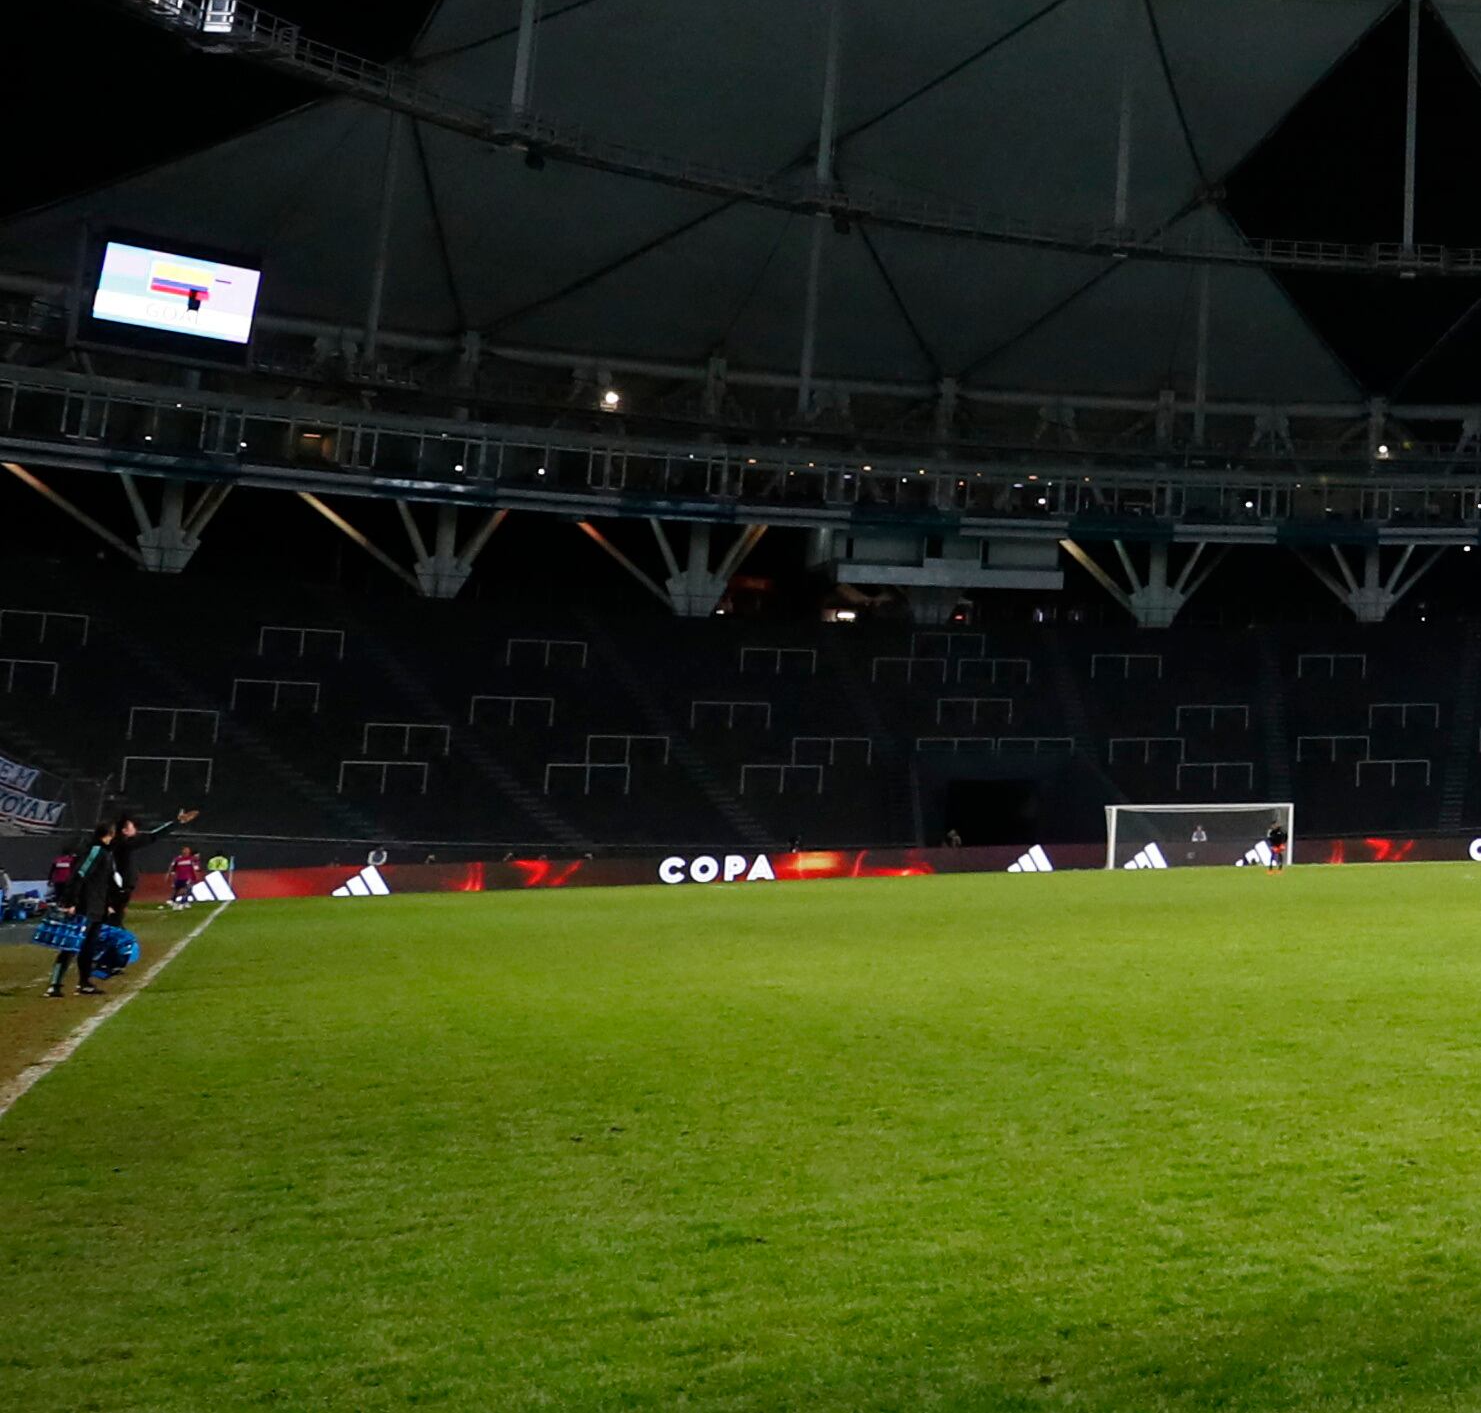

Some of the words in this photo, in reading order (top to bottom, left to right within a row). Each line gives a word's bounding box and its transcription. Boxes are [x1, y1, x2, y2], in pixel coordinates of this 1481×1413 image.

[0, 760, 36, 788] EM
[0, 793, 60, 822] OYAK
[658, 853, 776, 884] COPA
